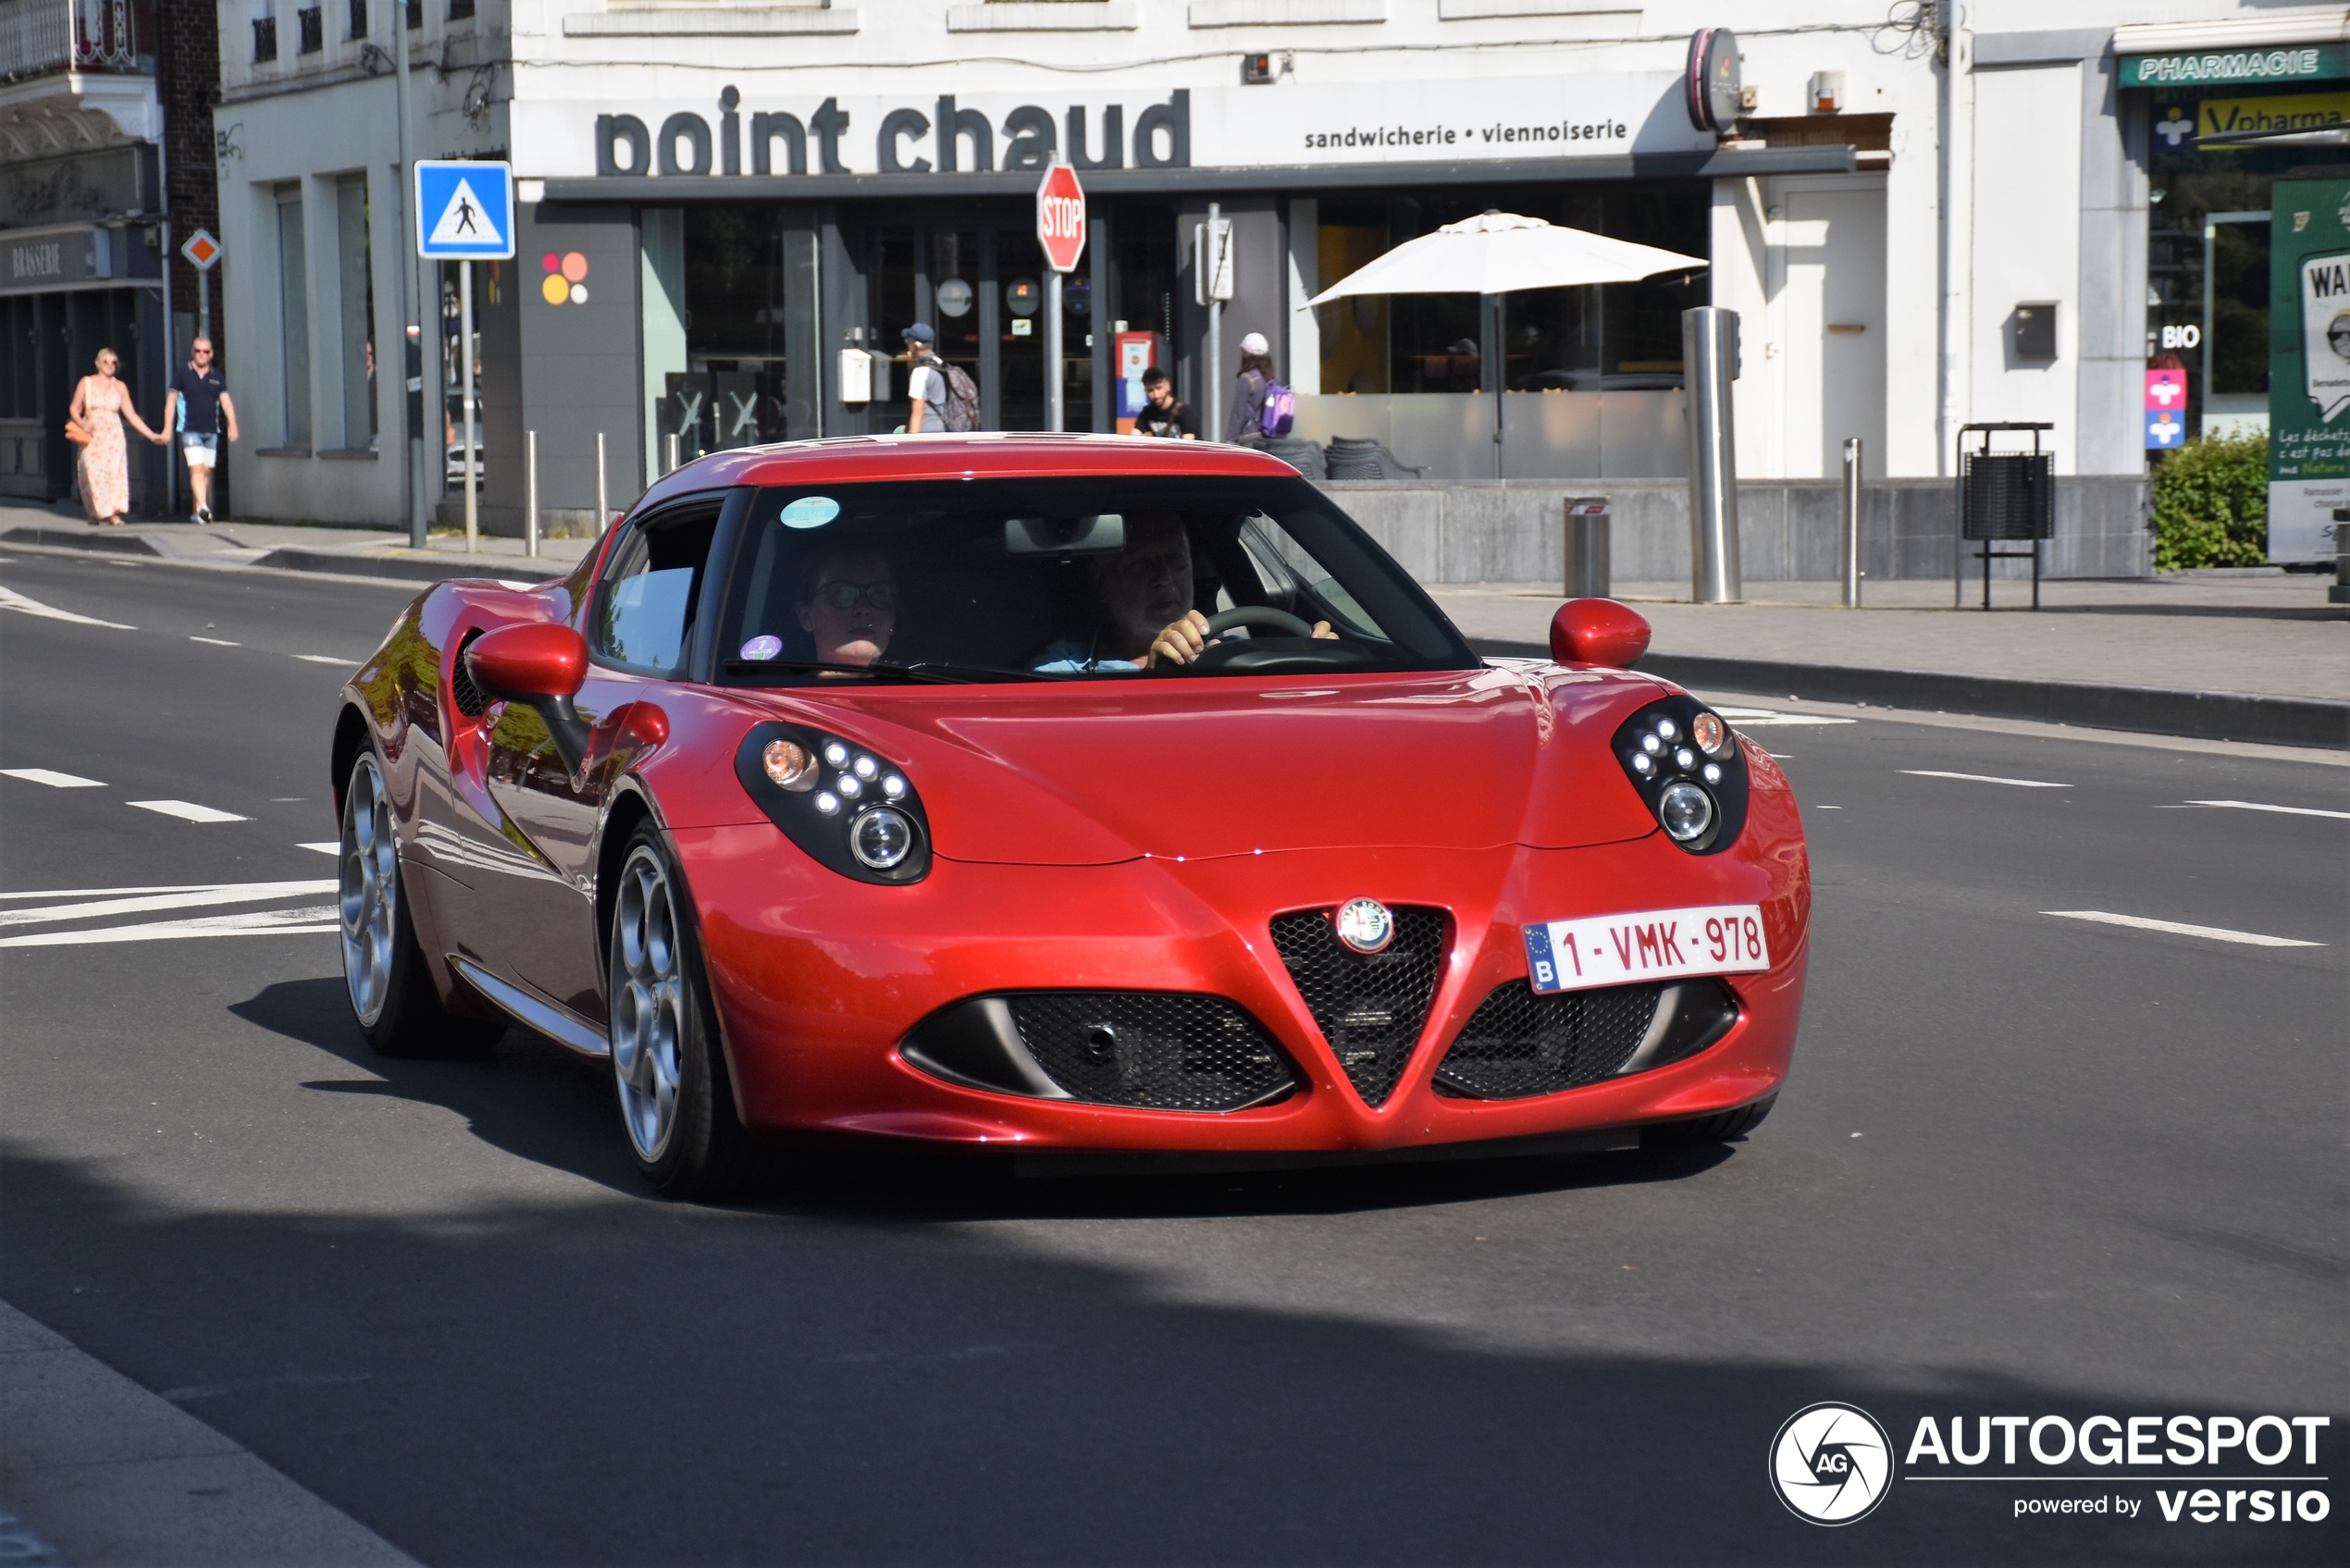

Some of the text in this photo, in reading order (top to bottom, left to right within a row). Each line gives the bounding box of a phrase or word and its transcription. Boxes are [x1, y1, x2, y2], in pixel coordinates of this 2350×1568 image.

[2138, 48, 2319, 81] PHARMACIE
[595, 84, 1190, 176] point chaud
[1305, 118, 1627, 149] sandwicherie viennoiserie
[1043, 196, 1082, 239] STOP
[2309, 264, 2350, 298] WA
[2161, 324, 2201, 349] BIO
[1563, 915, 1762, 978] 1-VMK-978
[1535, 960, 1554, 983] B
